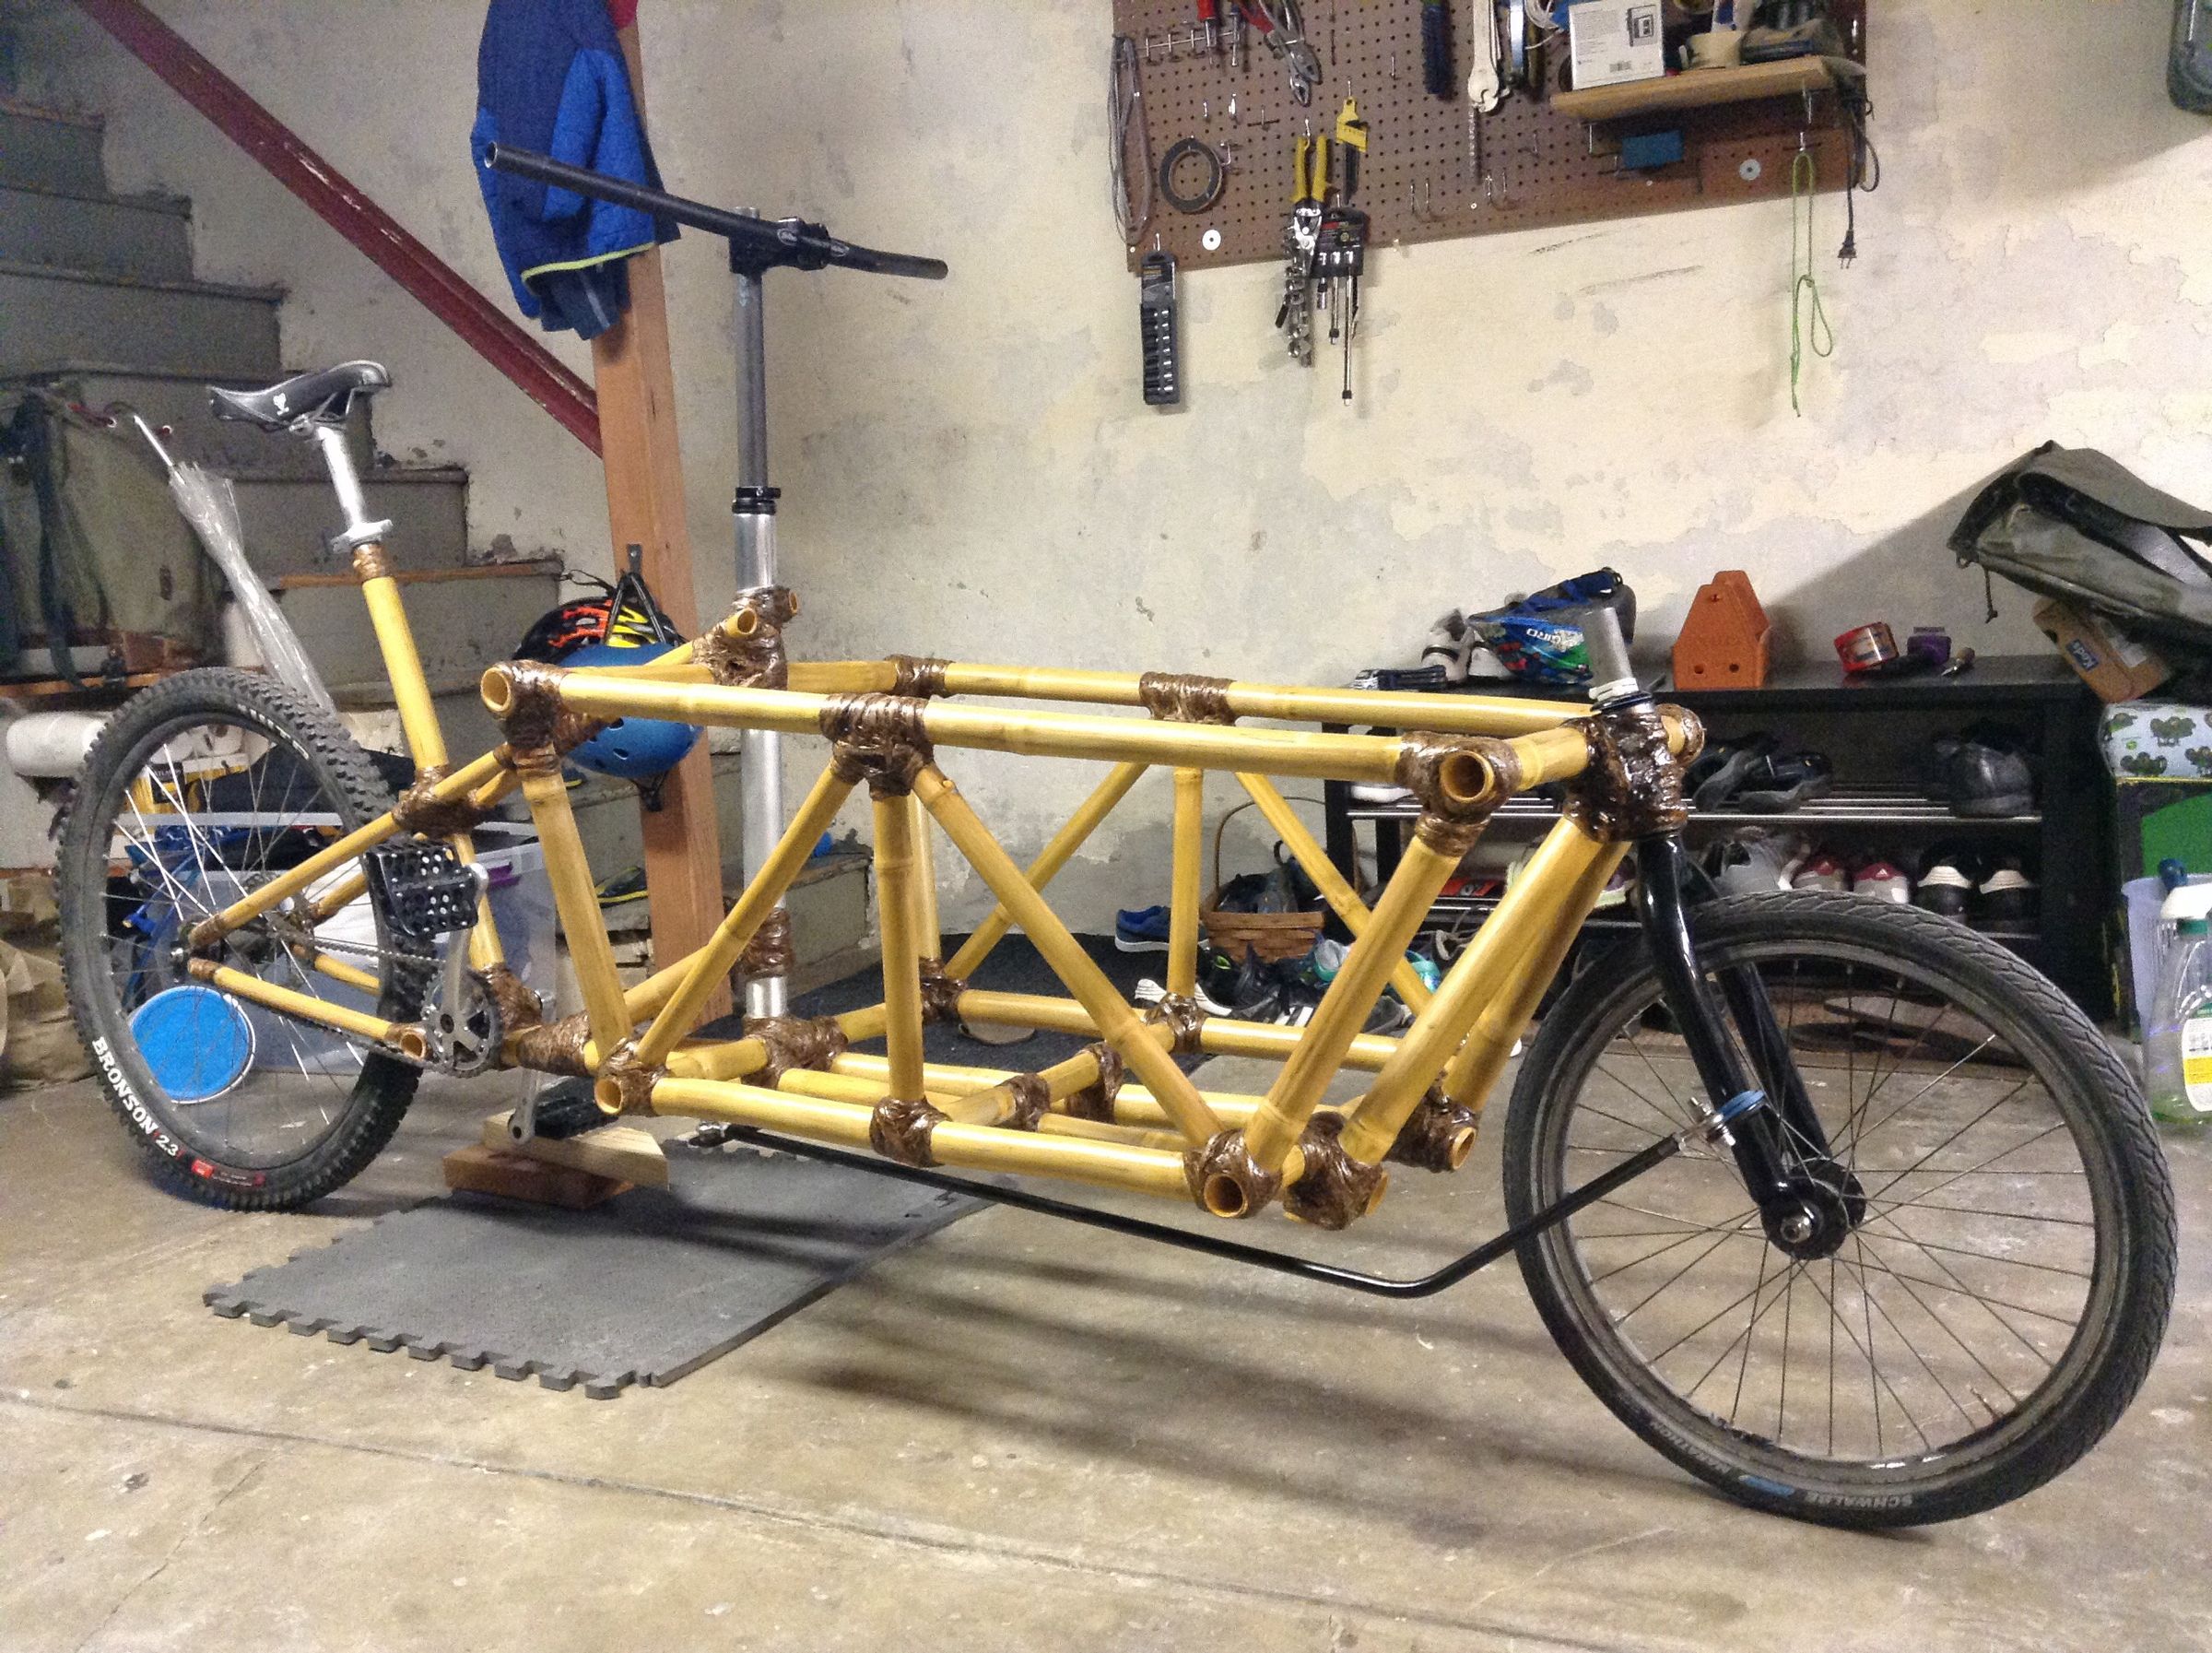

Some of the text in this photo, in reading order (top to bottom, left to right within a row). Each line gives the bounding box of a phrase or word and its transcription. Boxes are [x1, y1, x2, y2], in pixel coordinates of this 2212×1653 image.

[1526, 628, 1561, 643] GIRO
[92, 1036, 179, 1157] BRONSON 2.3
